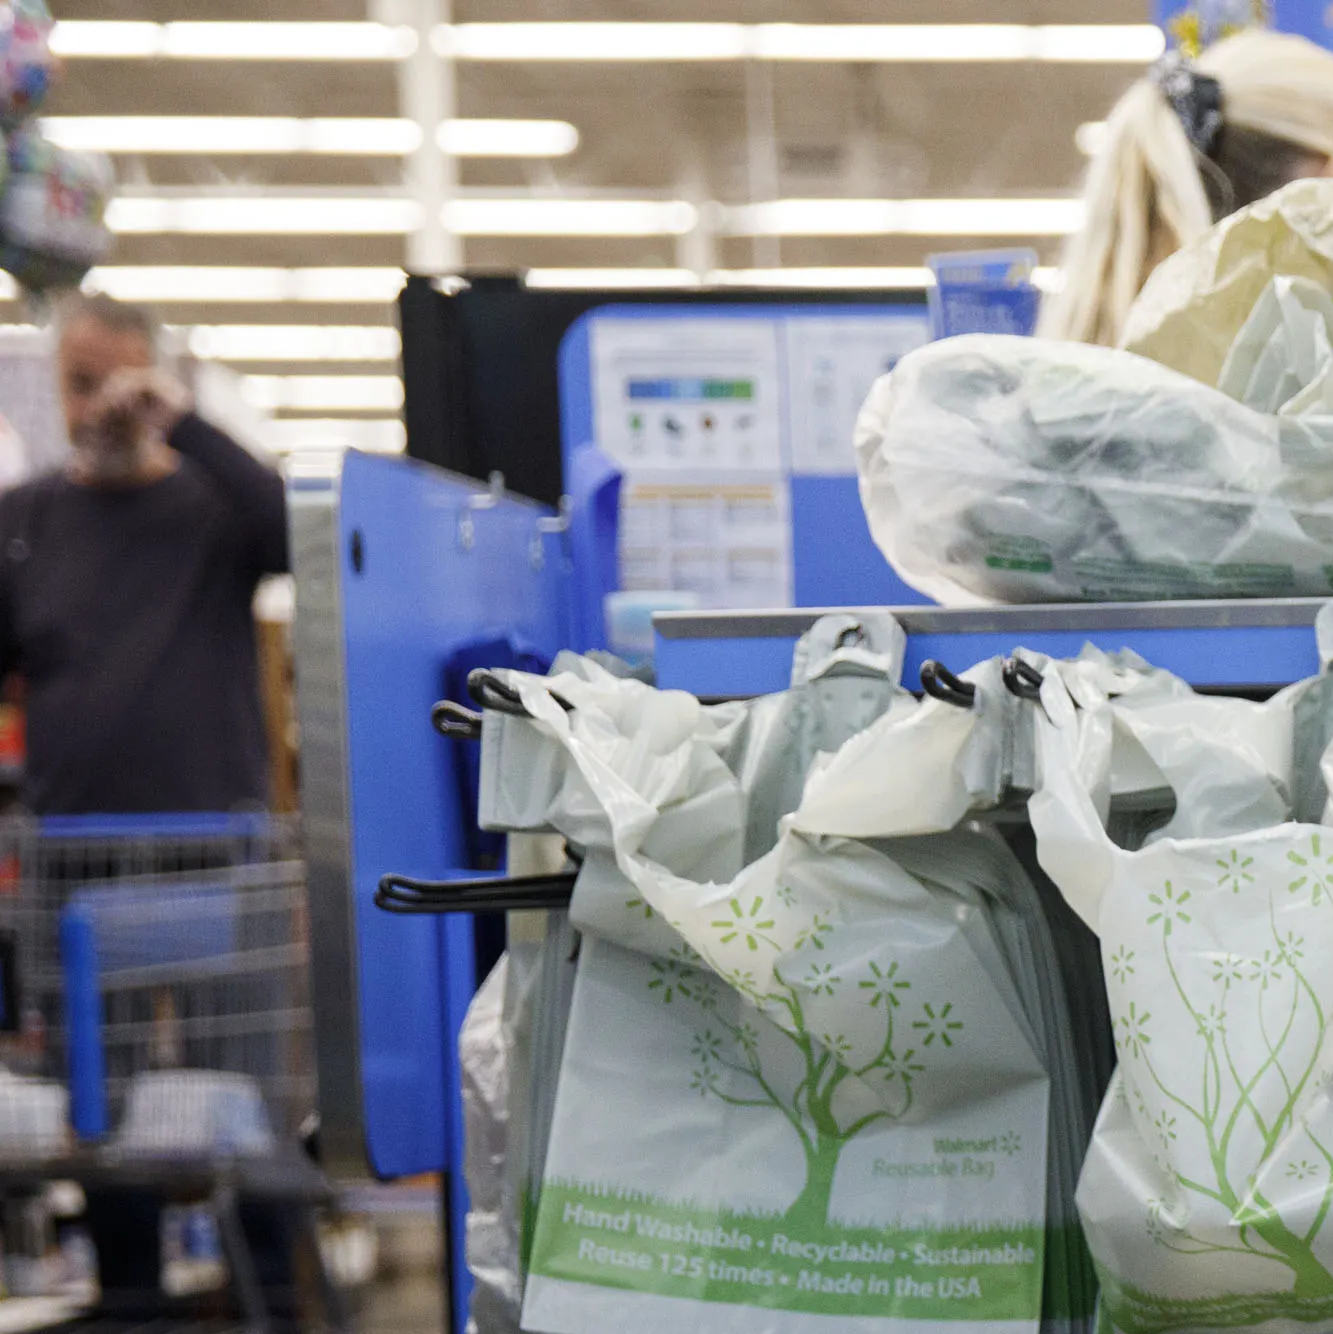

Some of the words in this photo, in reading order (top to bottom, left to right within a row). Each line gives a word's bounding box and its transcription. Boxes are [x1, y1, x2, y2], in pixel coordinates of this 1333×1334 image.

[934, 1136, 998, 1154] Walmart
[872, 1157, 956, 1178] Reusable
[961, 1157, 996, 1183] Bag
[562, 1202, 631, 1233] Hand
[634, 1213, 753, 1251] Washable
[770, 1233, 896, 1264] Recyclable
[914, 1243, 1035, 1266] Sustainable
[577, 1238, 652, 1270] Reuse
[660, 1253, 704, 1278] 125
[708, 1260, 774, 1286] times
[796, 1270, 864, 1296] Made
[867, 1273, 891, 1297] in
[896, 1275, 934, 1298] the
[938, 1276, 982, 1299] USA
